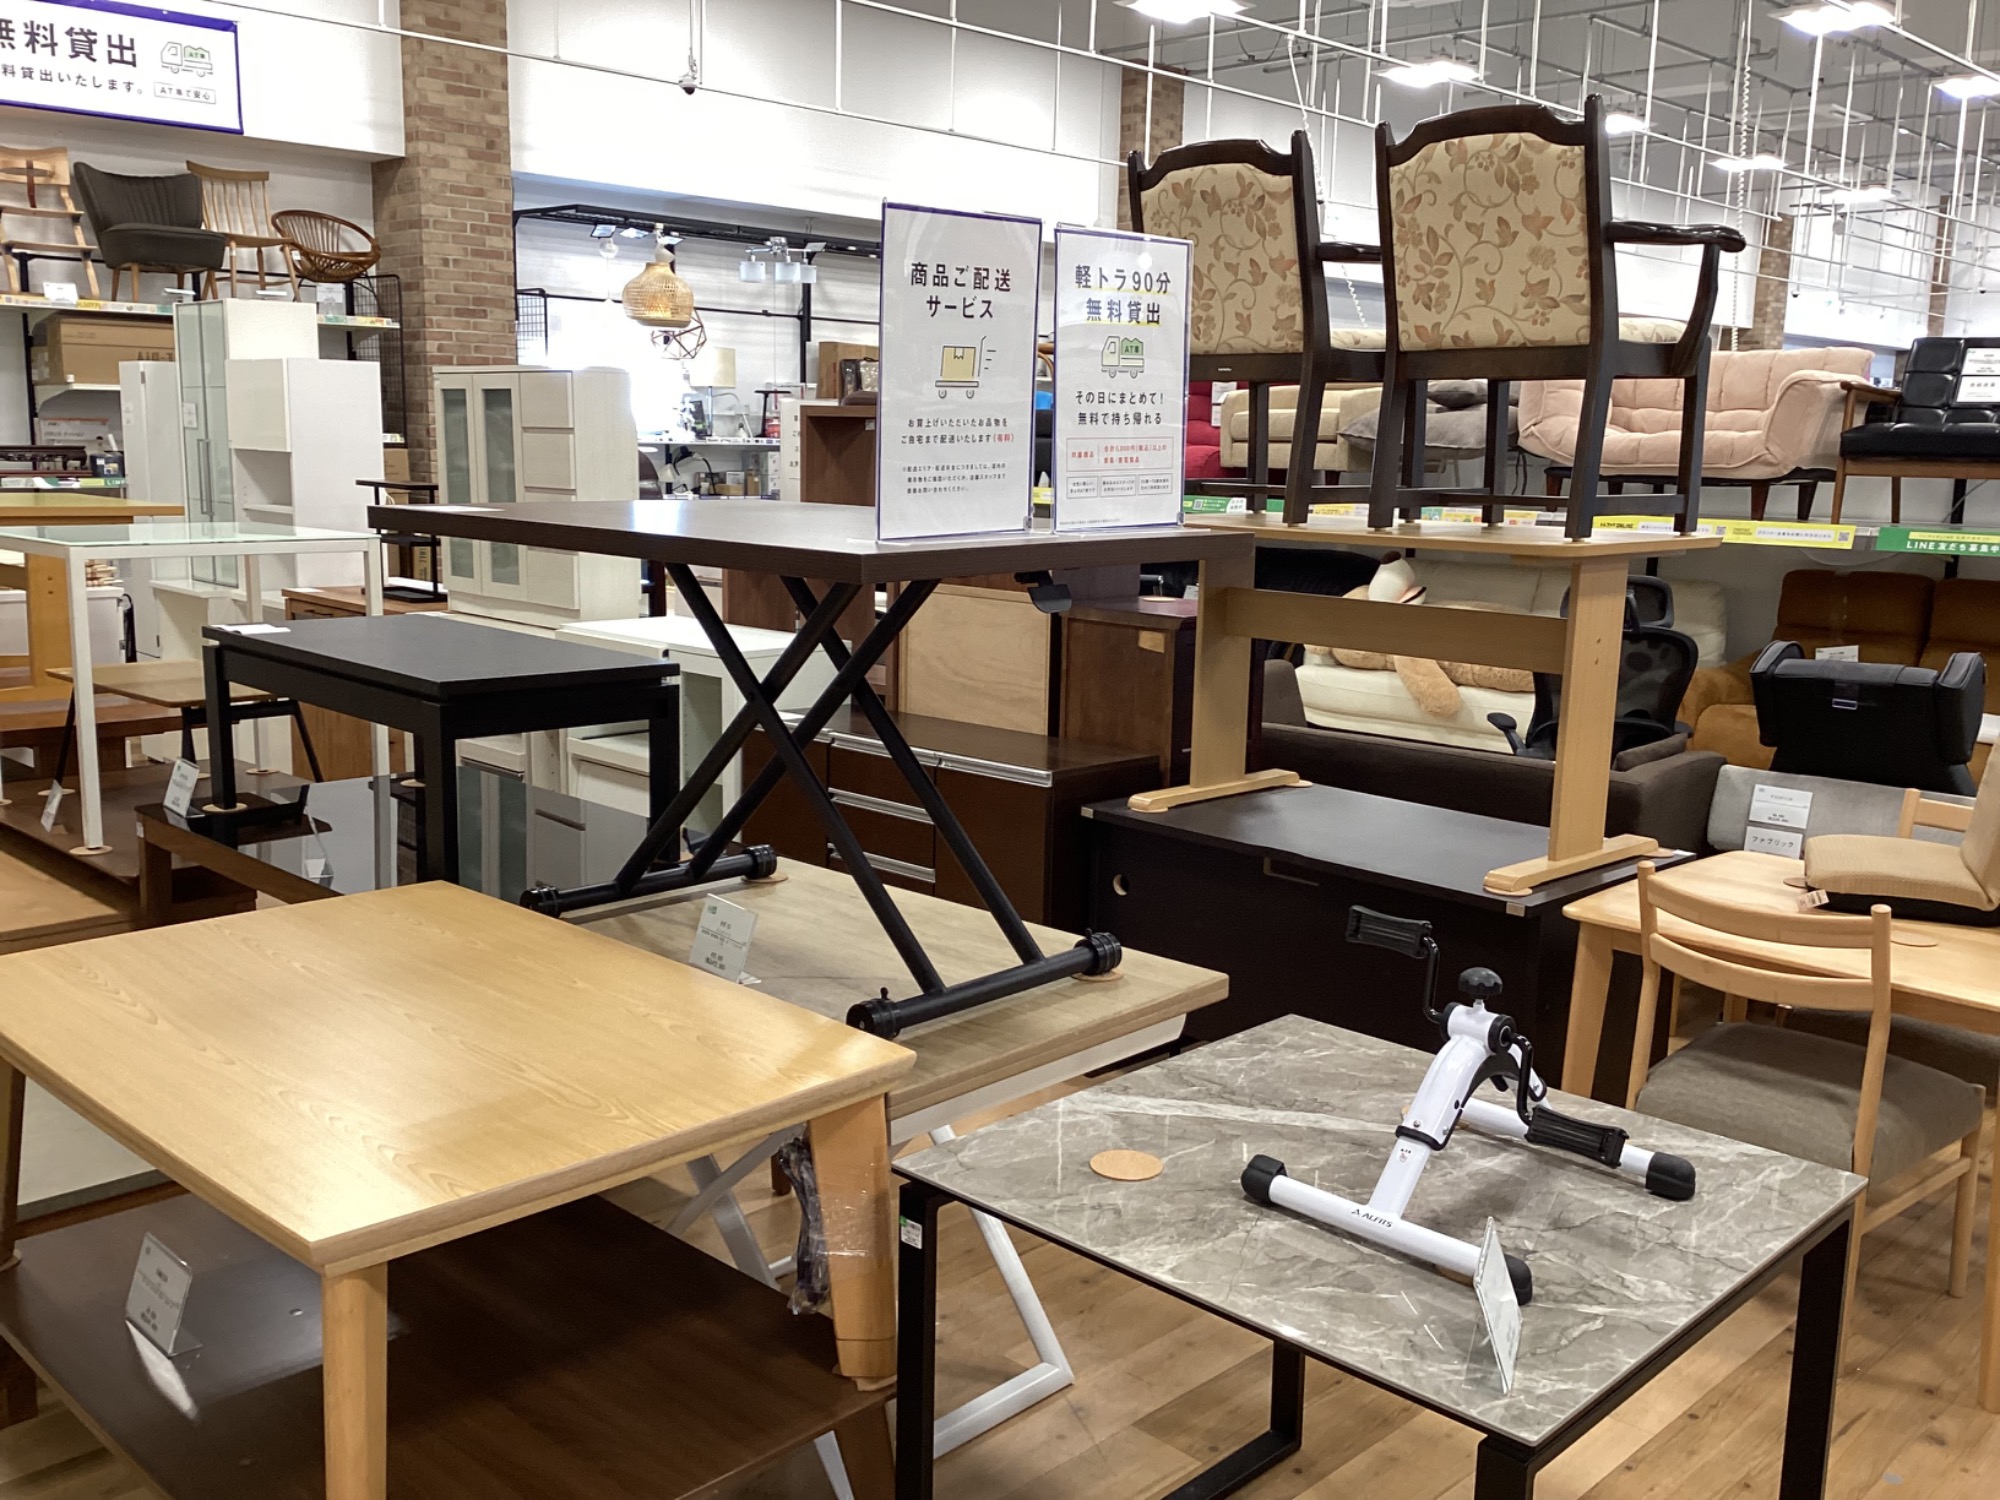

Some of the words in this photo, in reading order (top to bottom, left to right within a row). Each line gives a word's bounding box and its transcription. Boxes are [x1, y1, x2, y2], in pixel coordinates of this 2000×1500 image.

[0, 18, 138, 68] 無料貸出
[1, 64, 143, 95] 料貸出いたします。
[911, 262, 1011, 292] 商品ご配送
[1075, 264, 1171, 294] 軽トラ90分
[926, 295, 994, 319] サービス
[1086, 298, 1160, 324] 無料貸出
[1077, 411, 1162, 425] 無料で持ち帰れる
[1752, 835, 1794, 848] ファブリック
